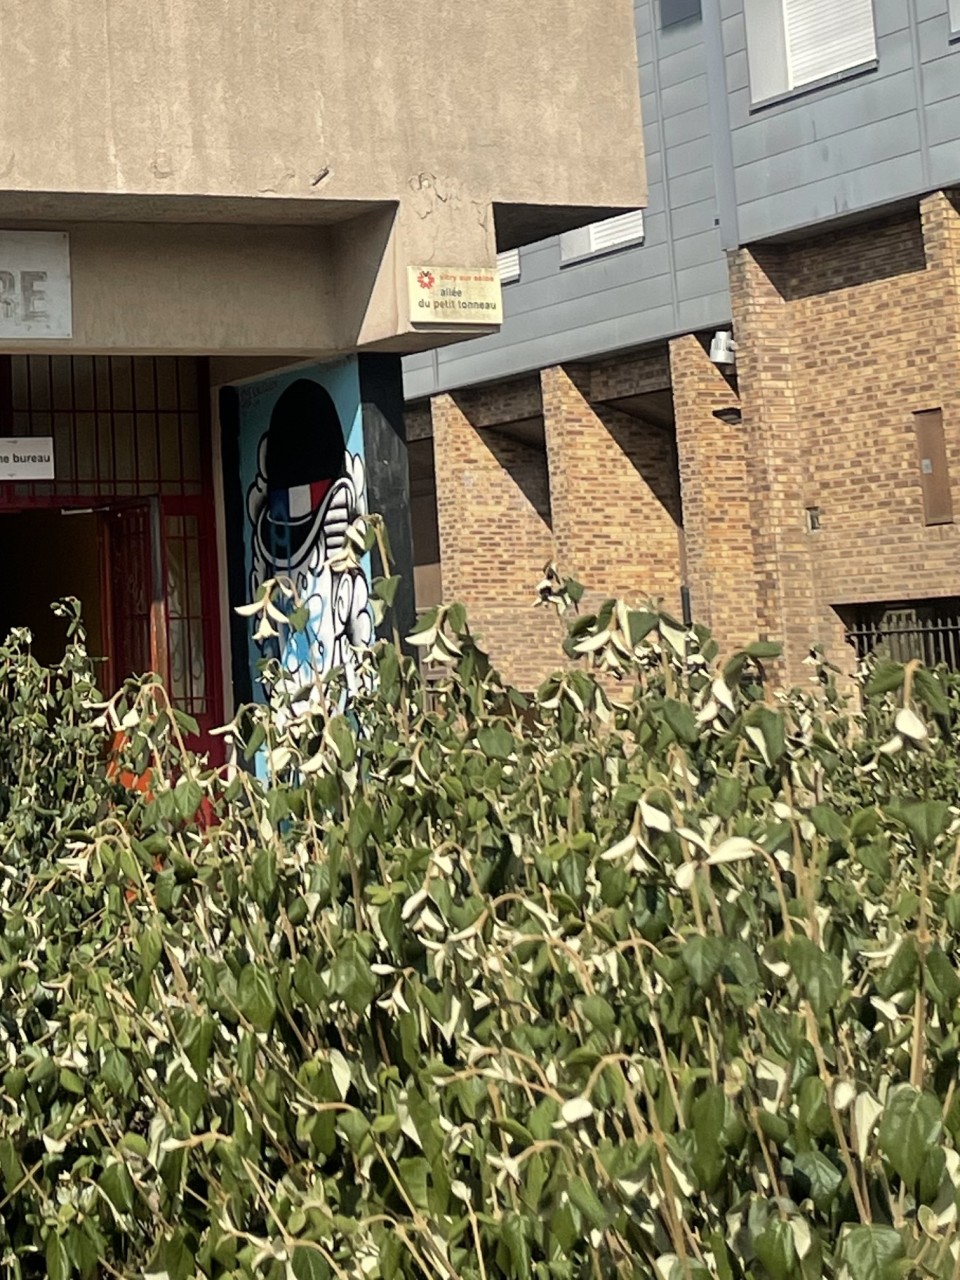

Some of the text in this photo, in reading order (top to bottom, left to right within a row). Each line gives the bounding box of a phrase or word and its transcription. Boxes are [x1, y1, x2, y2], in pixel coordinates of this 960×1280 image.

[440, 287, 462, 297] allée
[418, 299, 497, 310] du petit tonneau
[12, 453, 51, 463] bureau
